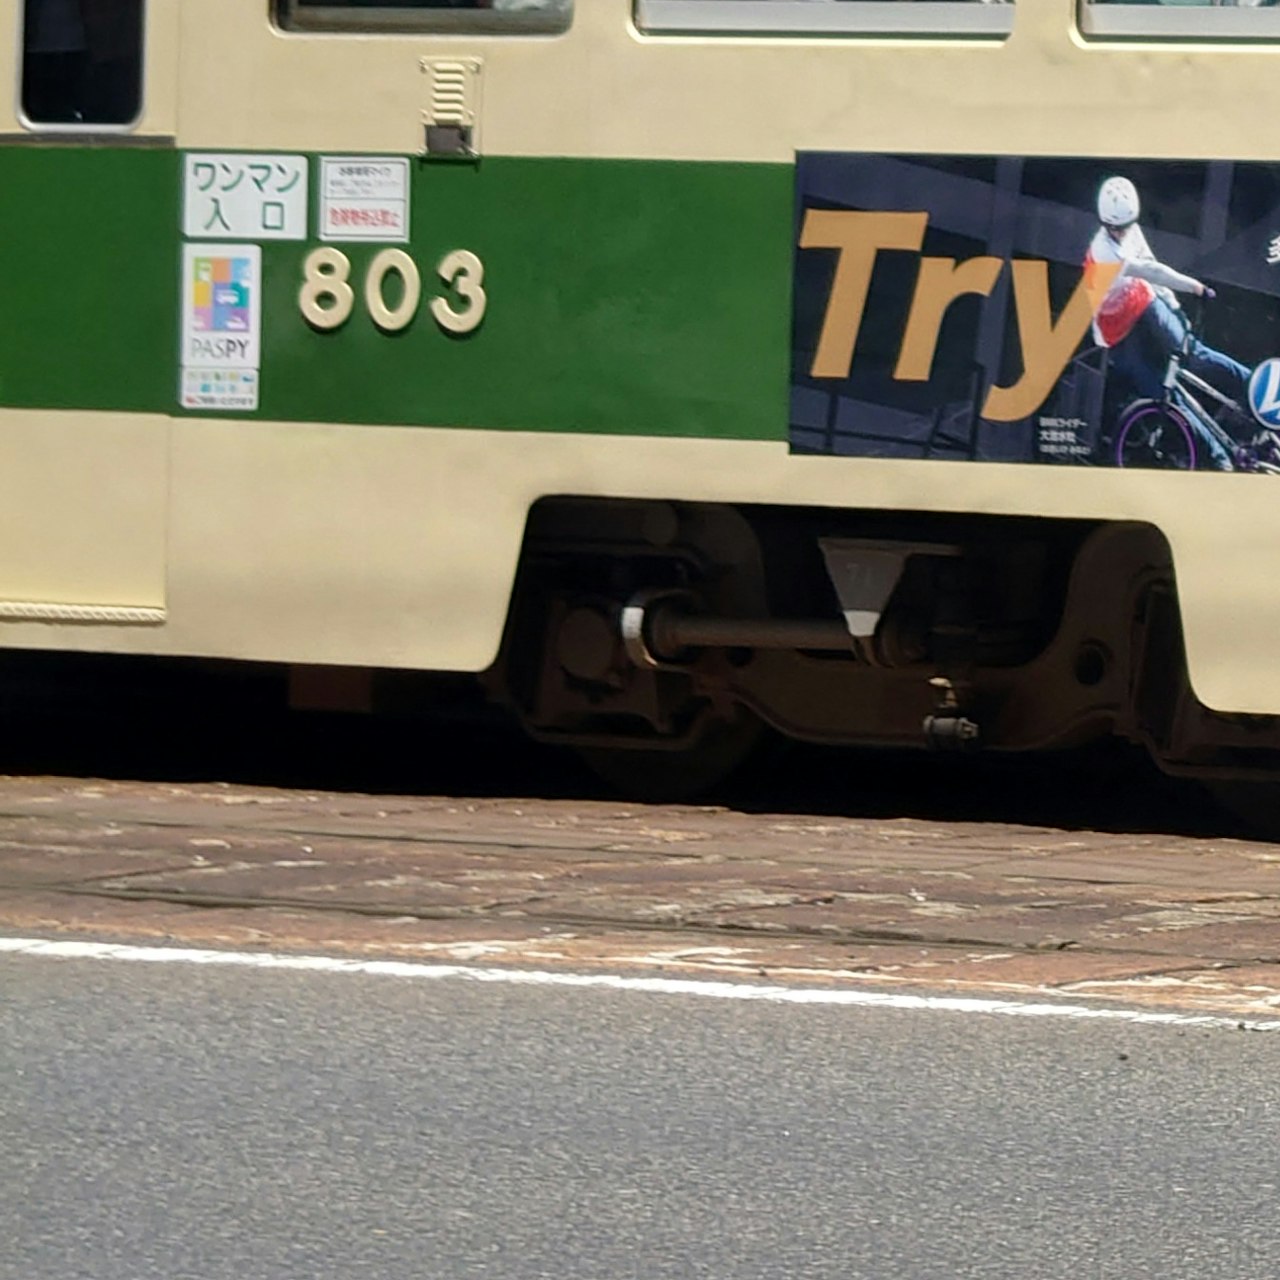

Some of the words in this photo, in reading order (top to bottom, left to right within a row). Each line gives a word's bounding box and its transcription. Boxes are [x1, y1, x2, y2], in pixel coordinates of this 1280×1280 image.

[193, 162, 300, 193] ワンマン
[300, 246, 488, 334] 803
[798, 207, 1126, 423] Try
[190, 338, 250, 359] PASPY
